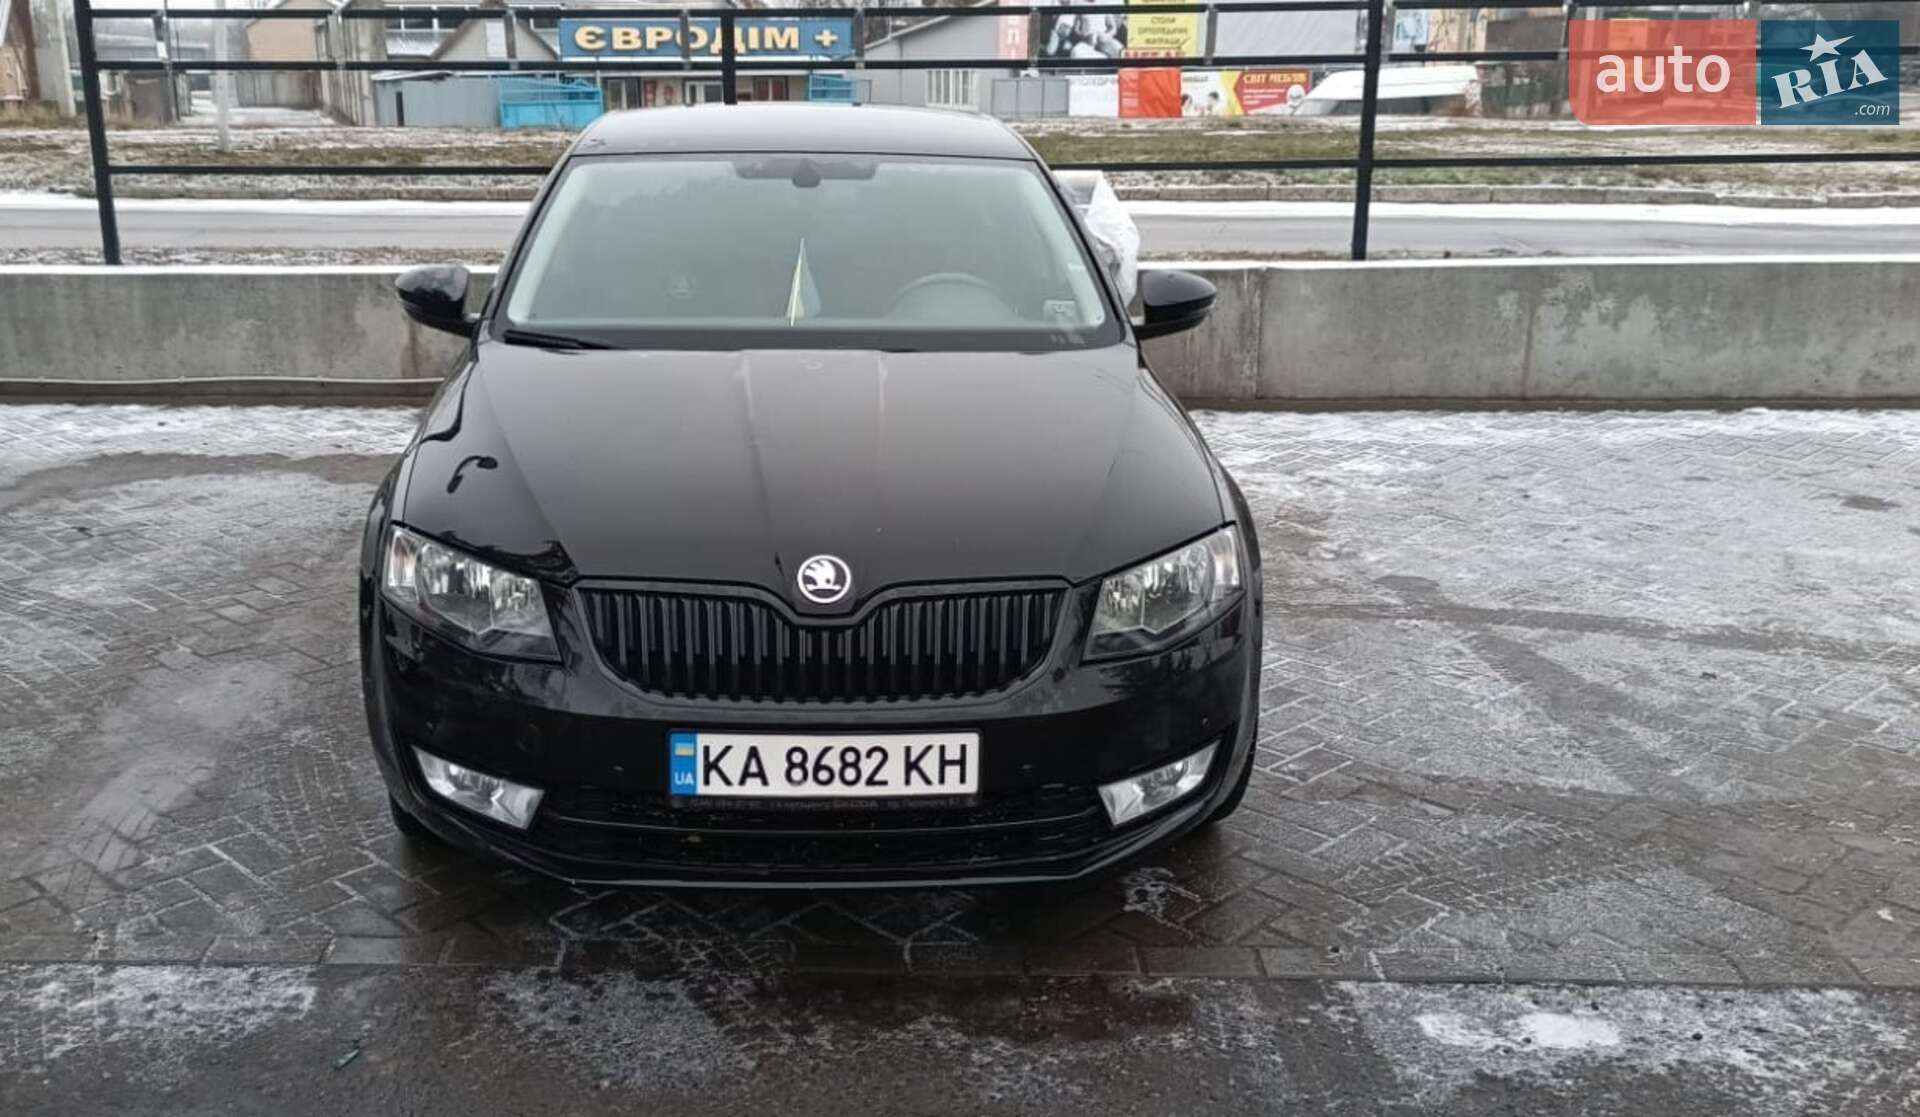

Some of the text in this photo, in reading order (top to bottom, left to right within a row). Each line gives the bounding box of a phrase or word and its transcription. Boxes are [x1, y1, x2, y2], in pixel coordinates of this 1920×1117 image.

[574, 26, 800, 54] ЄВРОДІМ
[1243, 73, 1266, 84] СВІТ
[702, 744, 967, 787] KA 8682 KH
[674, 772, 695, 785] UA
